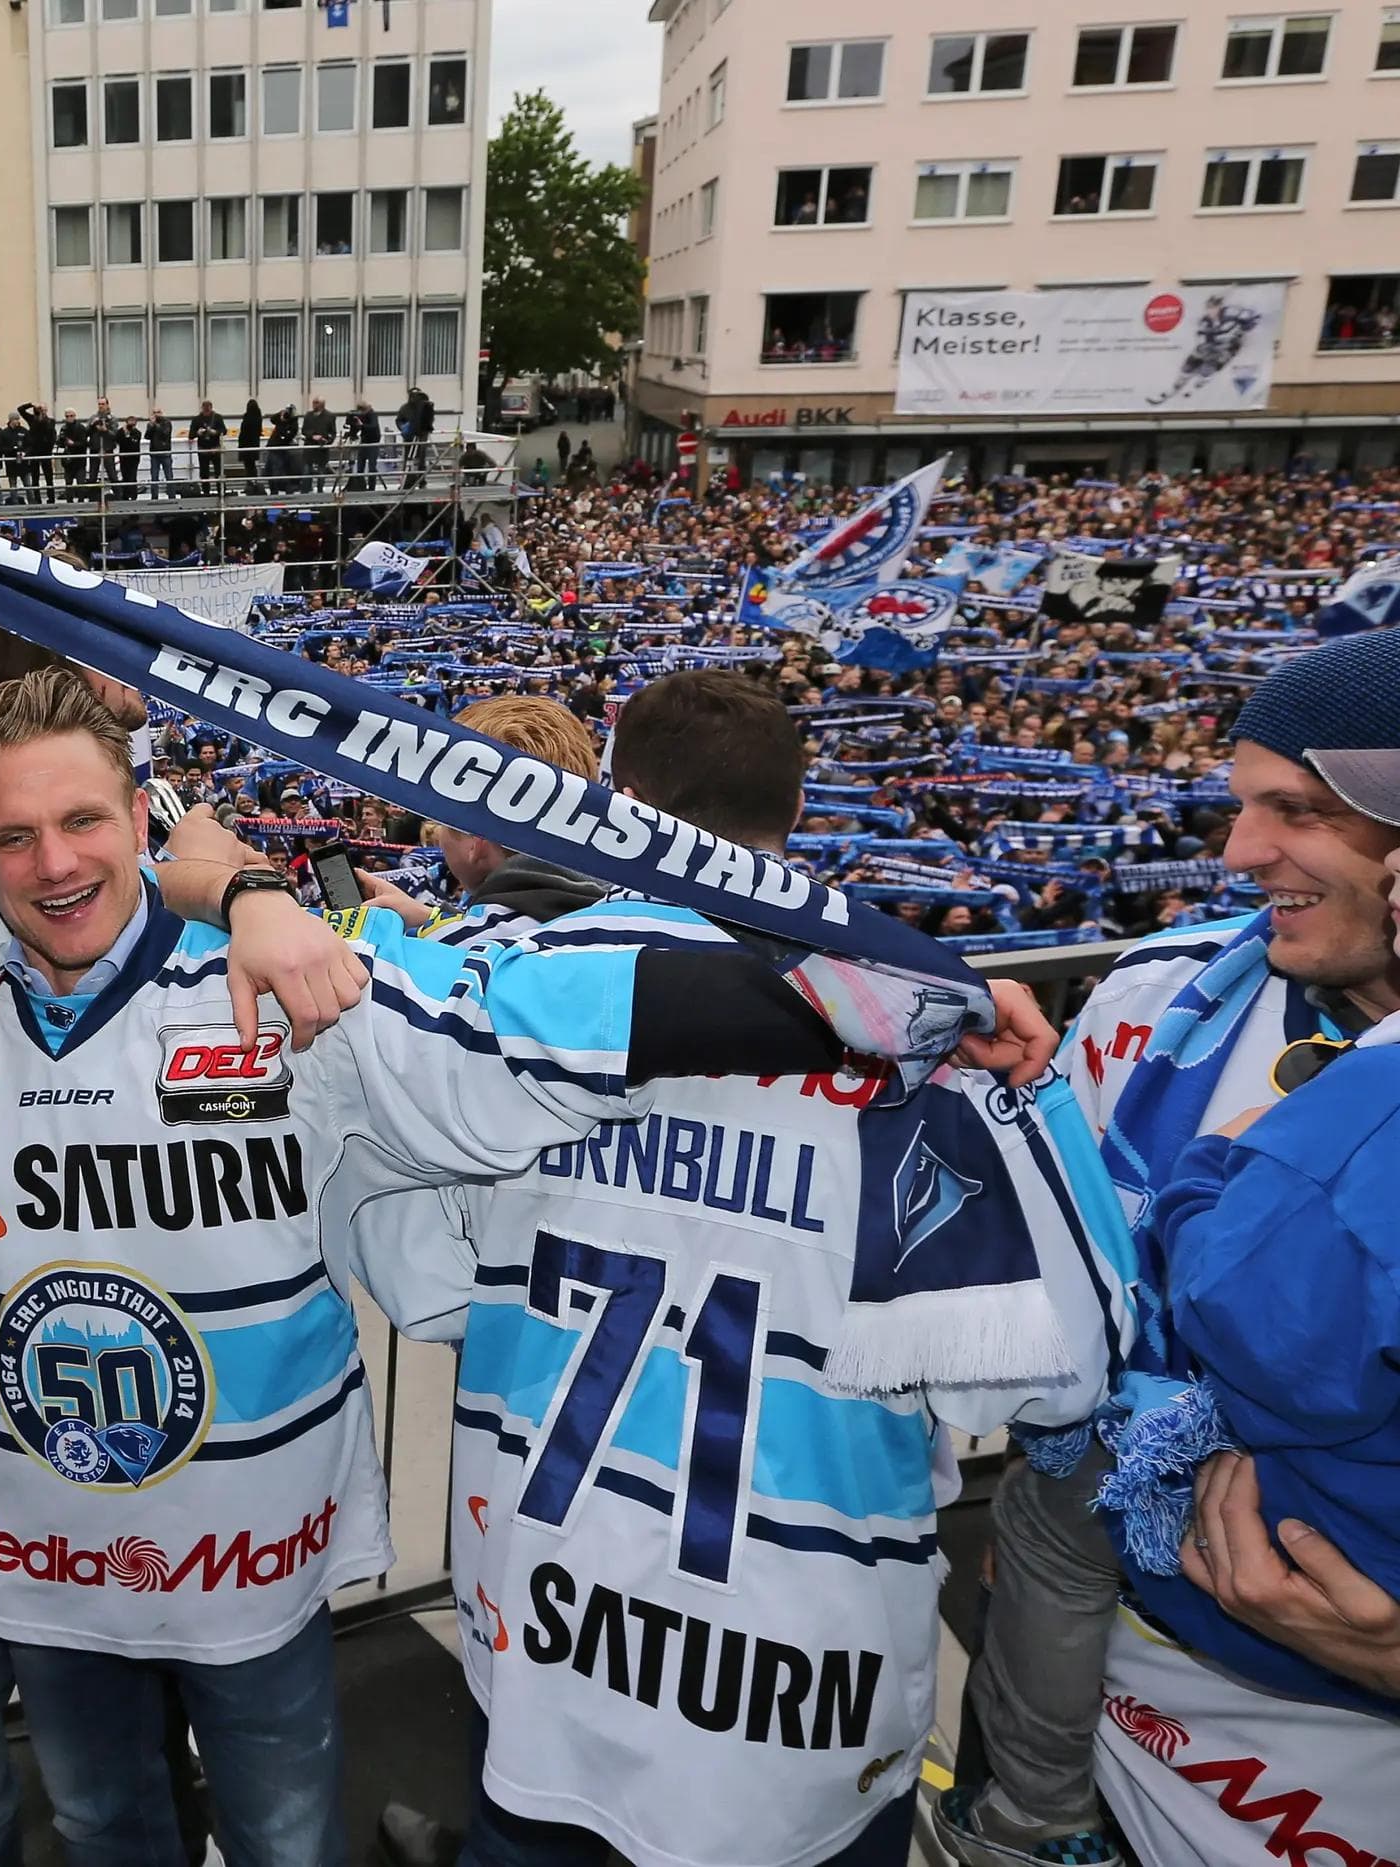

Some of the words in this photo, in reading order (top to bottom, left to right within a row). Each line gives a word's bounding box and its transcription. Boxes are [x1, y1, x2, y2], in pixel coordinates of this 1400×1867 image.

[912, 334, 1041, 356] Meister!
[915, 306, 1025, 328] Klasse,
[721, 408, 787, 427] Audi
[796, 407, 856, 425] BKK
[148, 643, 331, 738] ERC
[336, 709, 850, 927] INGOLSTADT
[199, 1100, 256, 1112] CASHPOINT
[13, 1133, 308, 1233] SATURN
[539, 1112, 825, 1233] RNBULL
[9, 1293, 46, 1333] ERC
[44, 1279, 170, 1330] INGOLSTADT
[0, 1353, 27, 1413] 1964
[33, 1344, 162, 1430] 50
[173, 1355, 197, 1419] 2014
[512, 1223, 768, 1591] 71
[55, 1422, 91, 1437] ERC
[49, 1451, 109, 1483] INGOLSTADT
[167, 1496, 337, 1593] Markt
[523, 1561, 884, 1750] SATURN
